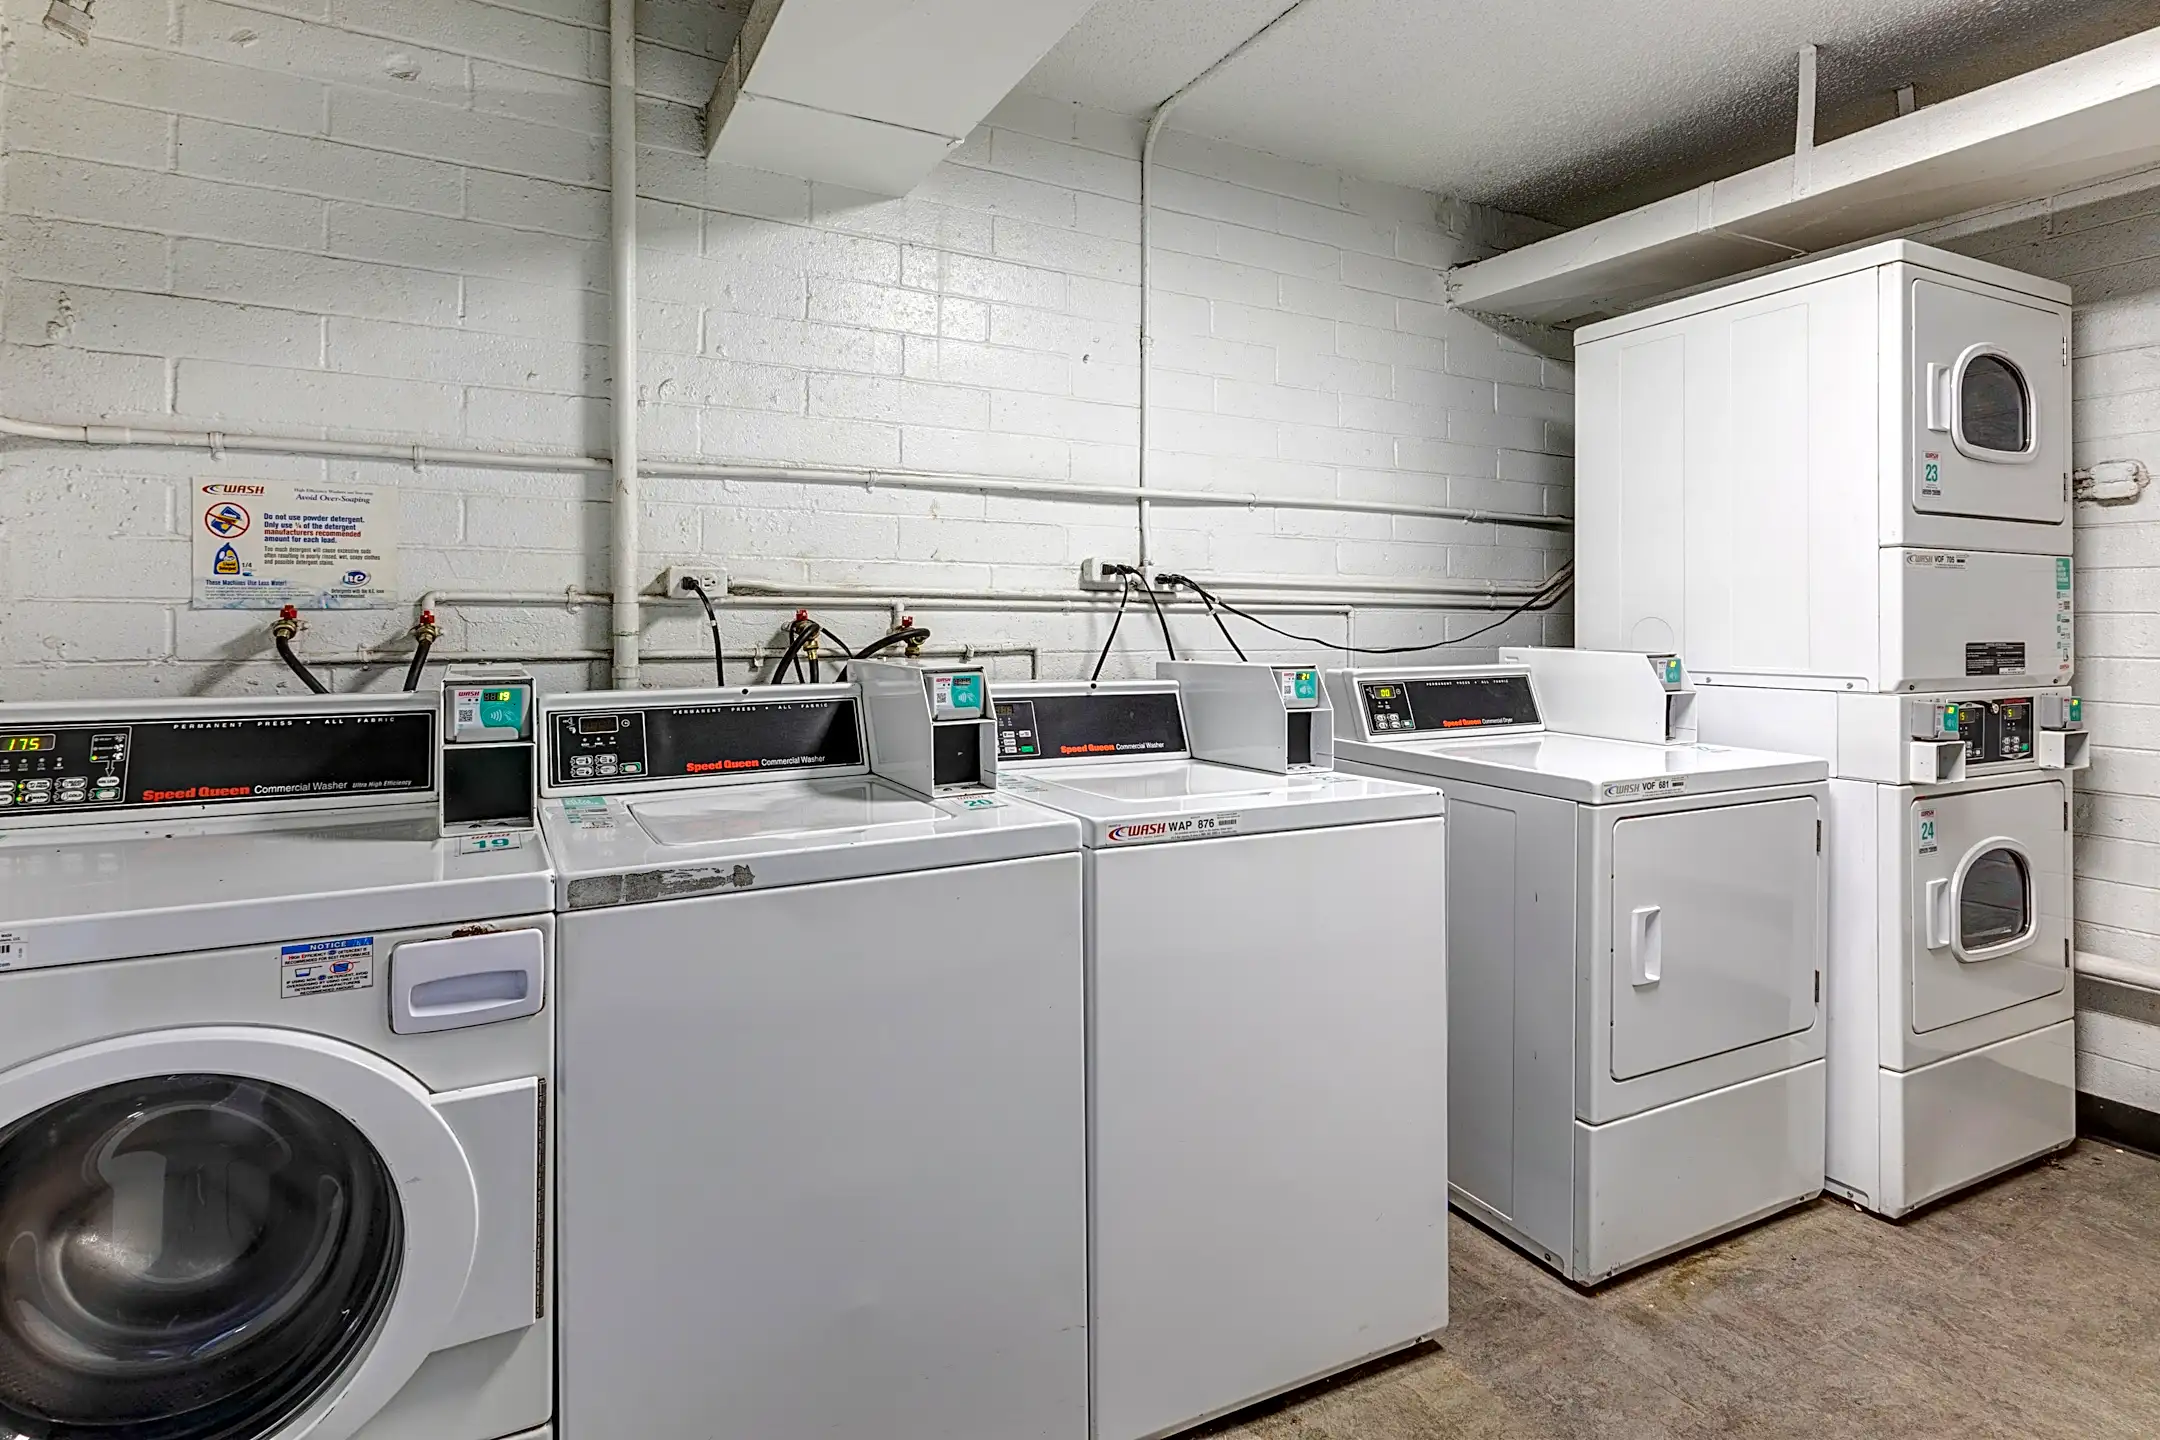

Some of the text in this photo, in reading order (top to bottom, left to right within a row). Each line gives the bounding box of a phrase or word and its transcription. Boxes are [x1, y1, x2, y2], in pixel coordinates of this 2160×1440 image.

[1926, 464, 1938, 482] 23
[224, 484, 264, 494] WASH
[320, 495, 370, 504] Over-Soaping
[330, 516, 364, 524] detergent.
[1443, 719, 1462, 728] Speed
[8, 738, 40, 750] 175
[1060, 744, 1088, 754] Speed
[1088, 743, 1115, 752] Queen
[1116, 742, 1146, 750] Commercial
[686, 756, 825, 772] Speed Queen Commercial Washer
[142, 786, 196, 802] Speed
[198, 786, 250, 798] Queen
[254, 782, 310, 794] Commercial
[312, 781, 348, 791] Washer
[383, 780, 412, 788] Efficiency
[1616, 783, 1640, 794] WASH
[1642, 782, 1656, 790] VOF
[1658, 780, 1668, 788] 681
[1128, 822, 1166, 836] WASH
[1168, 820, 1192, 832] WAP
[1198, 818, 1214, 829] 876
[1922, 822, 1934, 840] 24
[472, 838, 509, 848] 19
[310, 941, 346, 950] NOTICE
